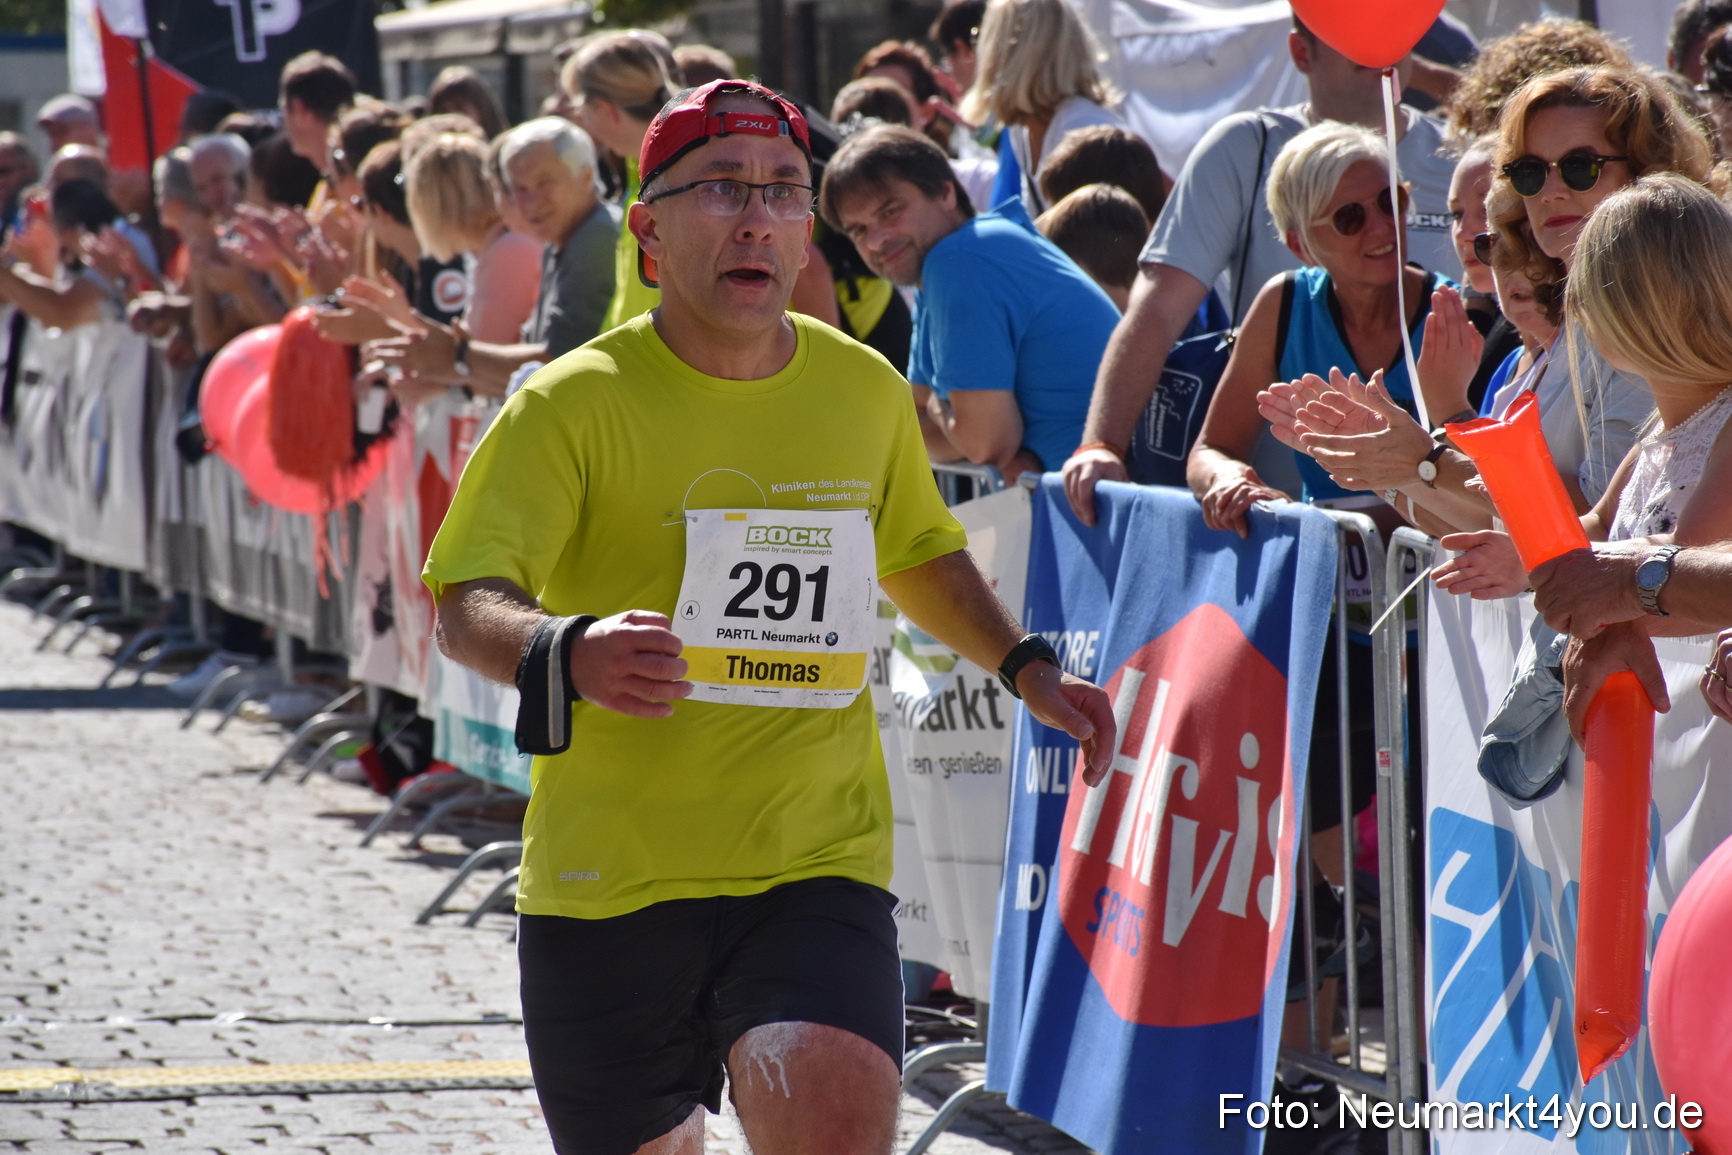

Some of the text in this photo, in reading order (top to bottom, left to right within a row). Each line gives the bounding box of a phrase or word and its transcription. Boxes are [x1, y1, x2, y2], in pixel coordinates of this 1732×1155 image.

[735, 119, 772, 130] 2XU
[771, 481, 815, 493] Kliniken
[818, 479, 834, 489] des
[806, 492, 851, 502] Neumarkt
[745, 526, 833, 547] BOCK
[724, 561, 829, 622] 291
[686, 605, 694, 616] A
[716, 628, 820, 644] PARTL Neumarkt
[726, 655, 820, 683] Thomas
[559, 871, 600, 882] SPIRO
